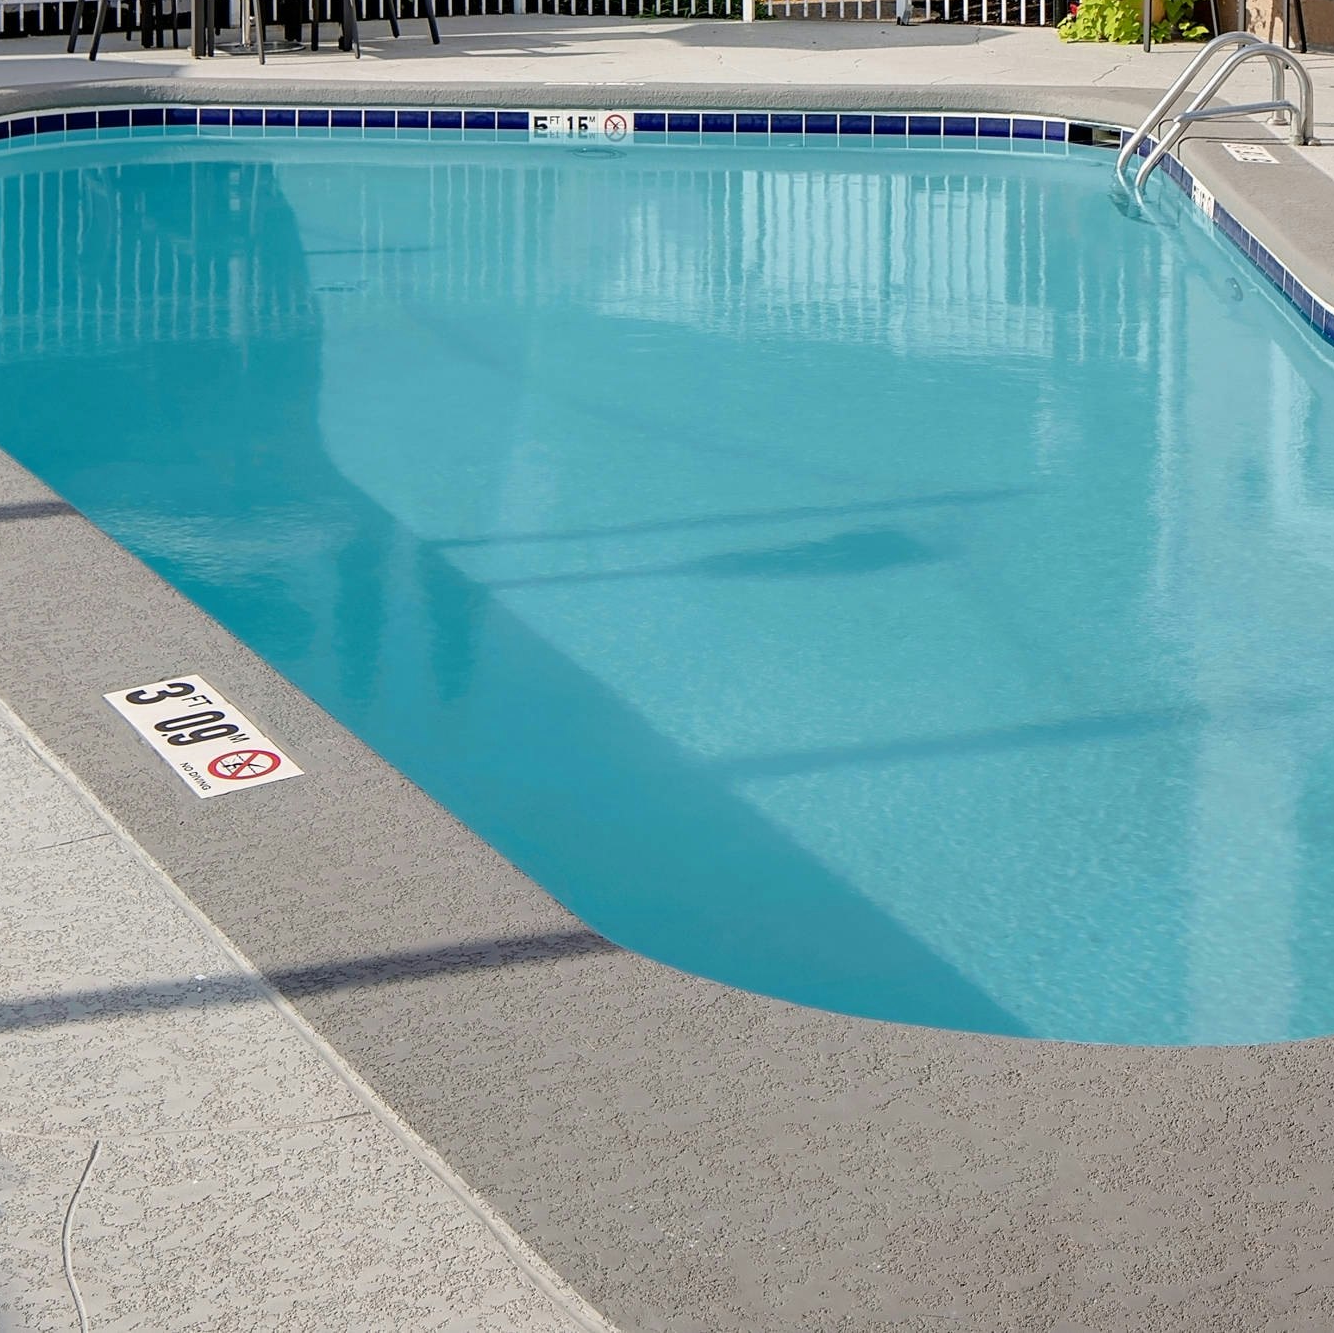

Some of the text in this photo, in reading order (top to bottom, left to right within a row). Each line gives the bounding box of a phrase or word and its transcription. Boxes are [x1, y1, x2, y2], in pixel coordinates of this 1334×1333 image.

[534, 116, 548, 130] 5
[550, 116, 560, 124] FT
[125, 682, 195, 705] 3
[182, 695, 213, 707] FT
[228, 733, 250, 744] M
